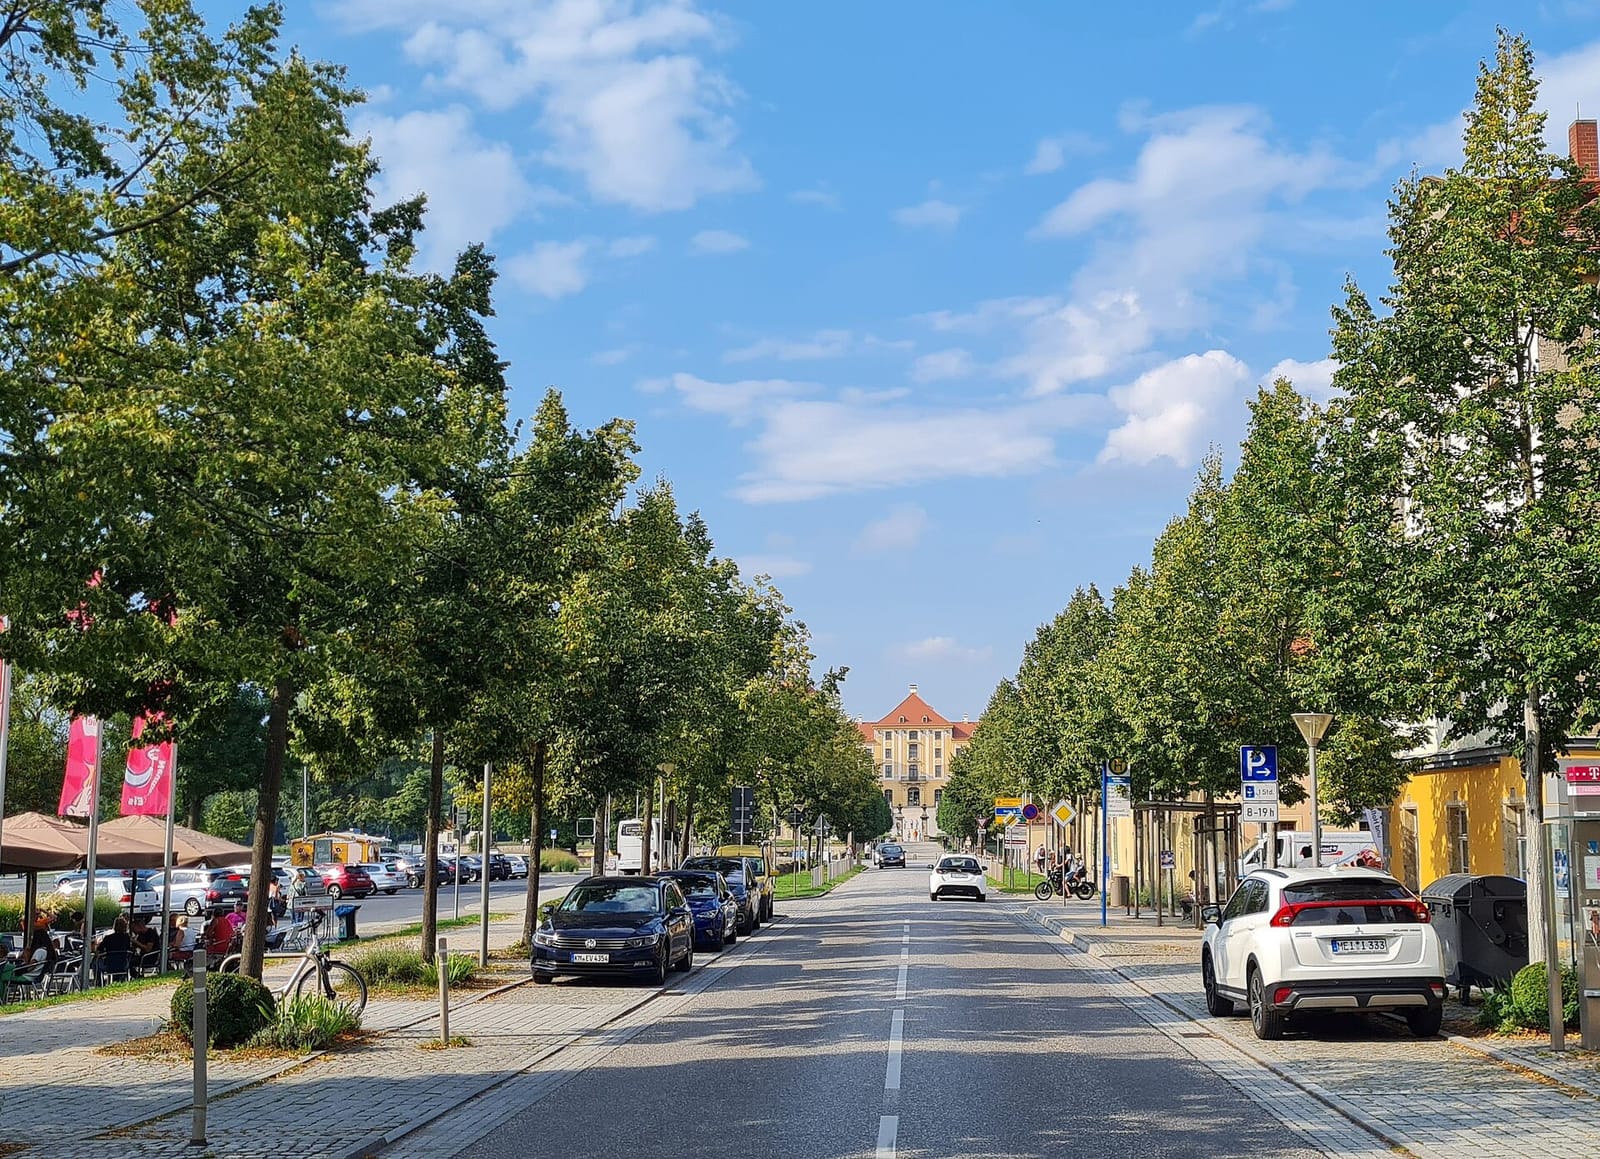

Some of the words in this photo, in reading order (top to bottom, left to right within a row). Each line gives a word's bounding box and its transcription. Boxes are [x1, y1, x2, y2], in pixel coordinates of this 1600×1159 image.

[1246, 750, 1266, 777] P
[1247, 807, 1268, 817] 8-19
[1269, 807, 1275, 817] h
[1367, 940, 1385, 950] 333
